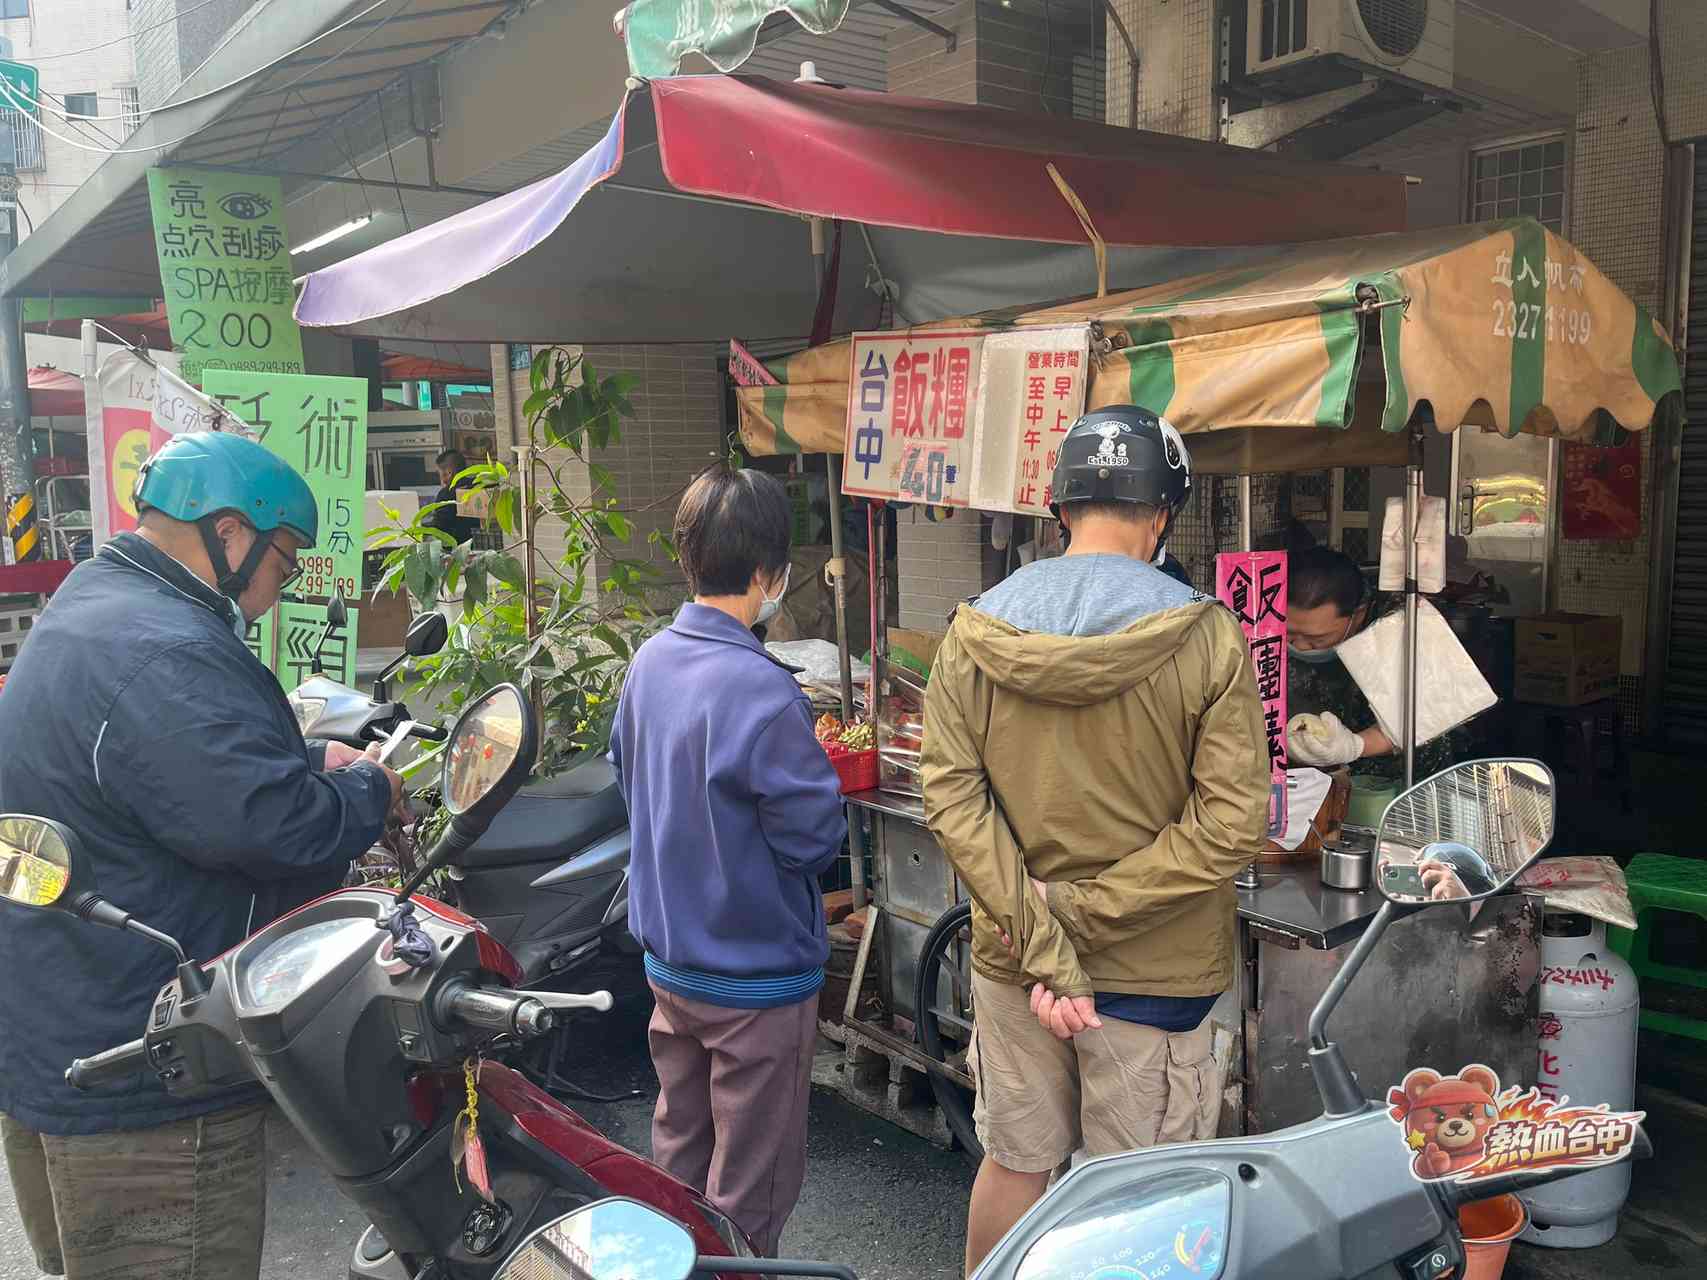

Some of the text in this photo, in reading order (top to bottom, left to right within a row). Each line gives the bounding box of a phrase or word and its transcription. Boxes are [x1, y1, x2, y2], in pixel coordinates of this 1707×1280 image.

[168, 180, 207, 220] 亮
[175, 266, 291, 305] SPA按摩
[180, 309, 271, 349] 200
[855, 350, 889, 480] 台中
[327, 497, 351, 528] 15
[328, 531, 354, 553] 分
[1487, 1119, 1628, 1163] 熱血台中
